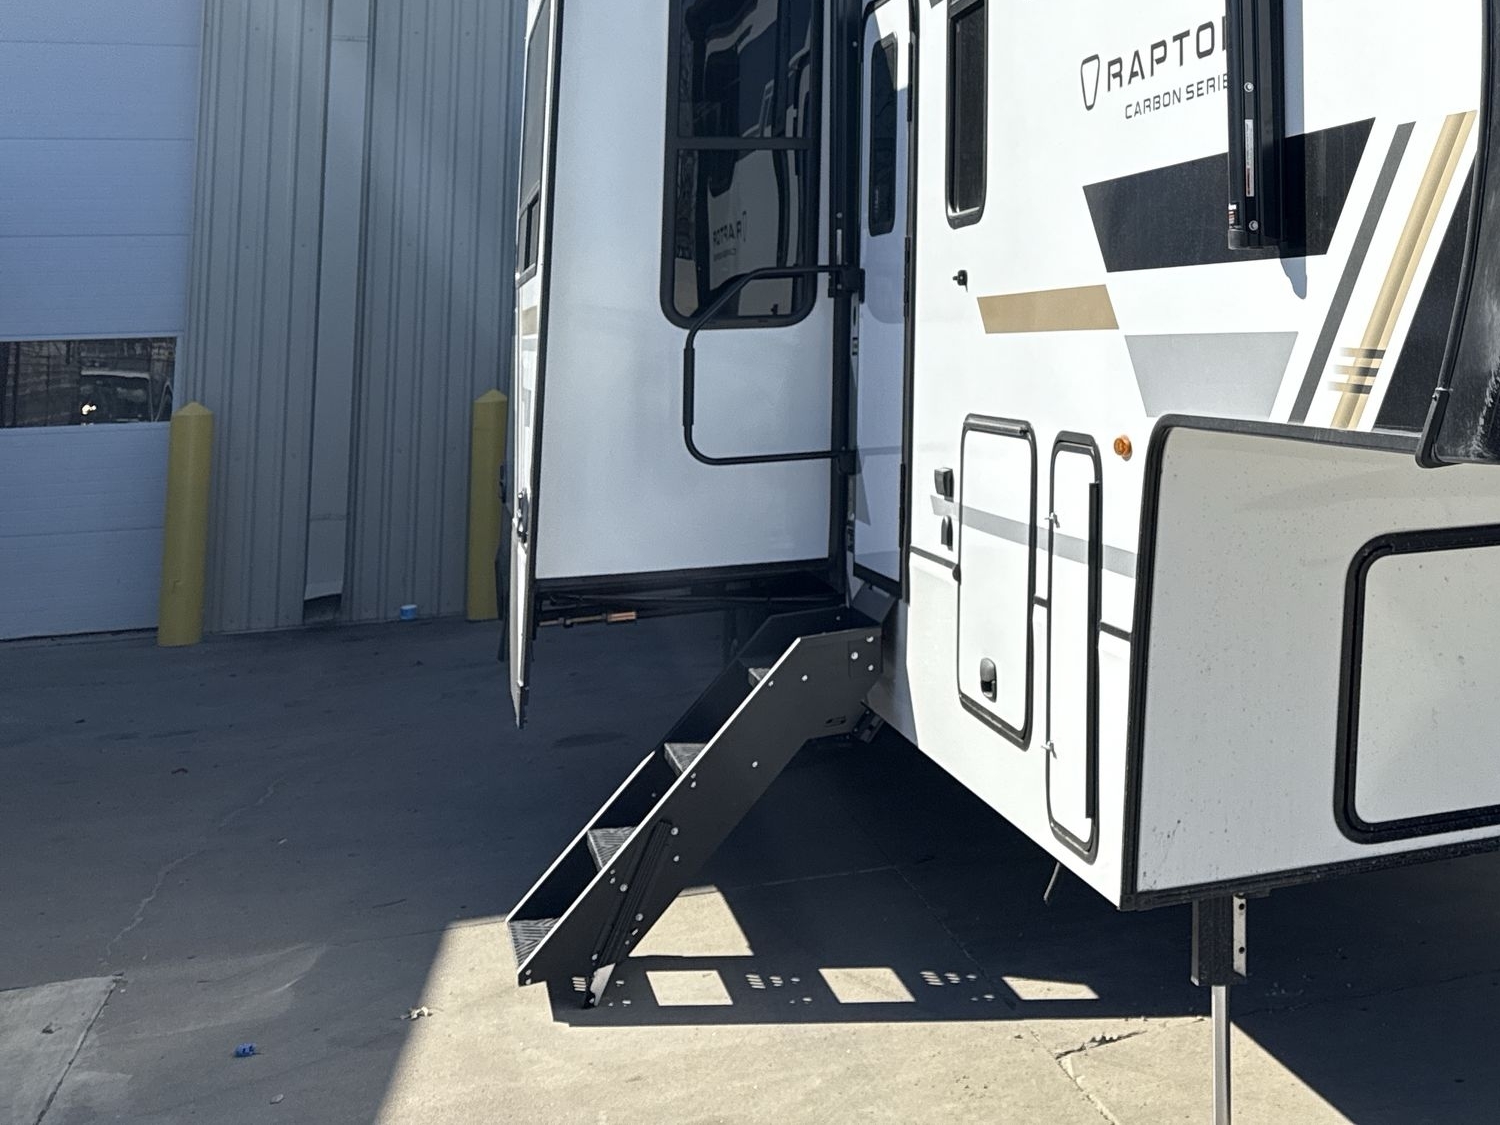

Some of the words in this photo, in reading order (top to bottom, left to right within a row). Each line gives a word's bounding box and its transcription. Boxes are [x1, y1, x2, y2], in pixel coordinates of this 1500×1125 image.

[1107, 15, 1227, 92] RAPTO
[1125, 87, 1181, 120] CARBON
[1186, 72, 1229, 101] SERIE
